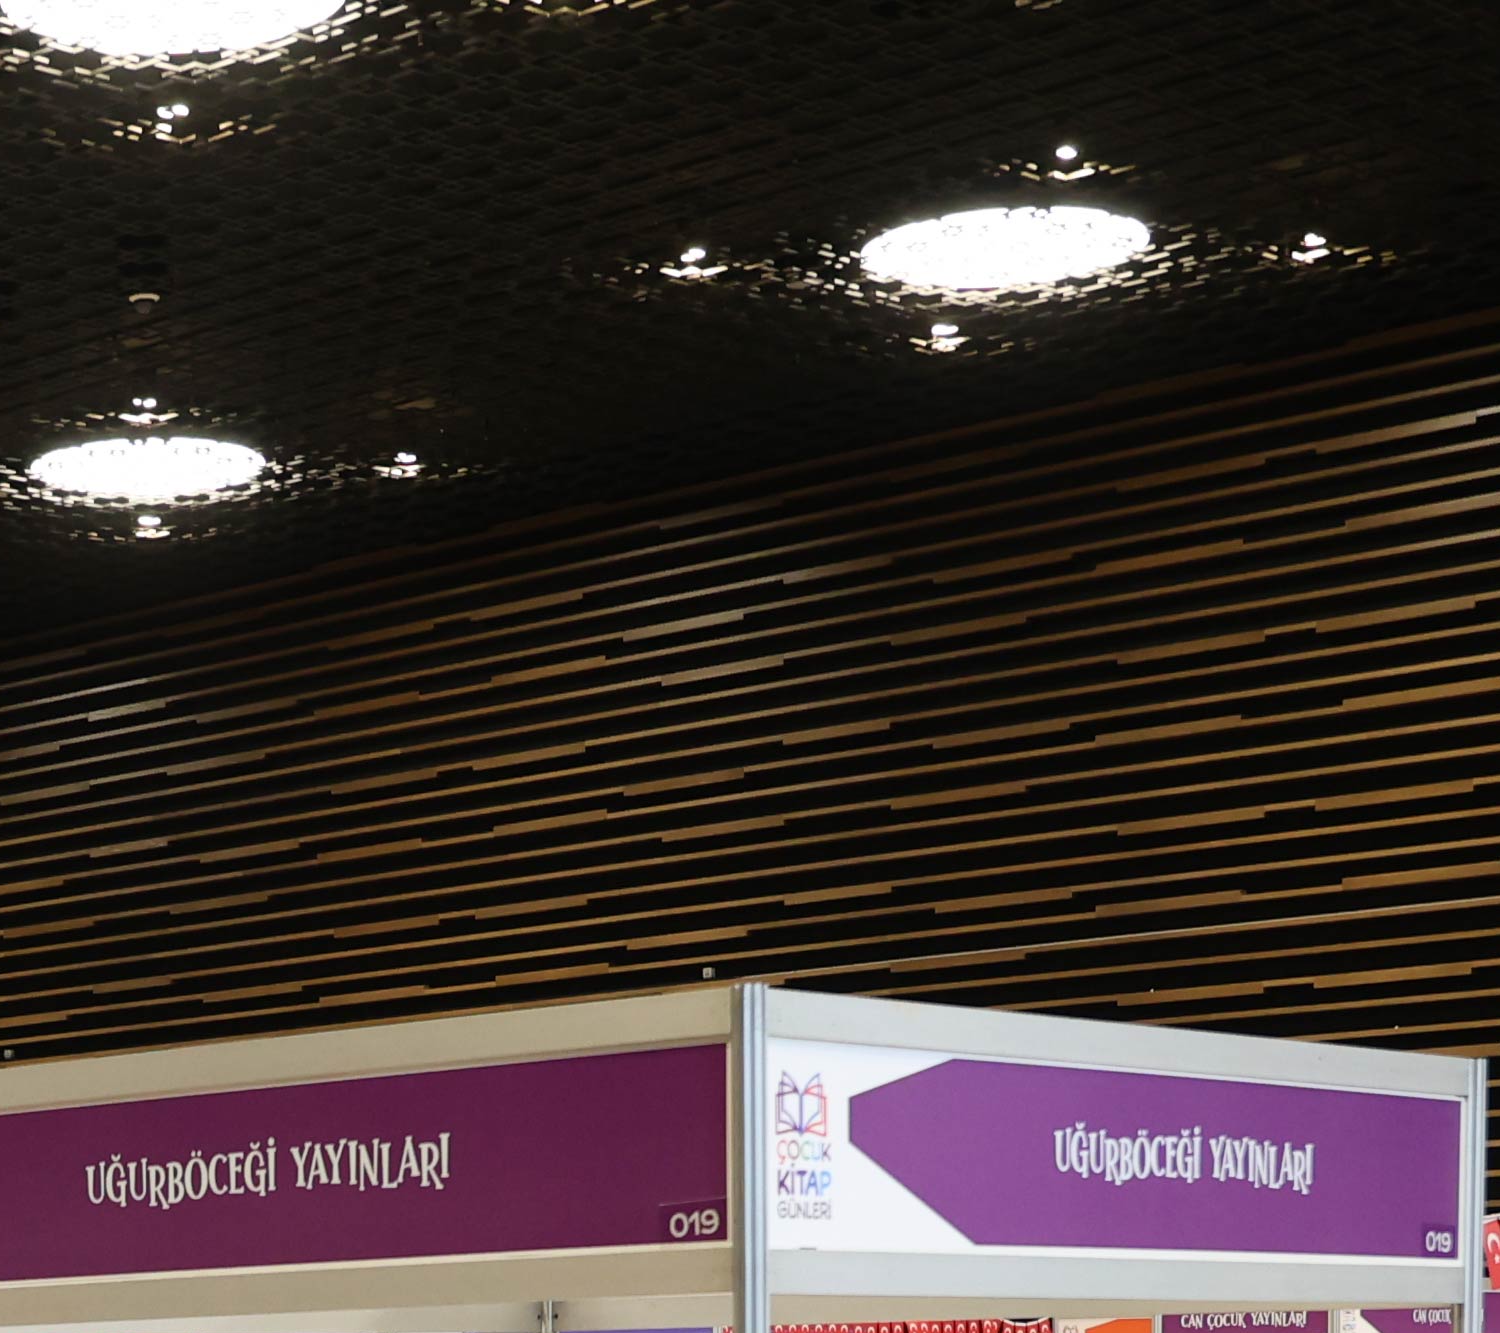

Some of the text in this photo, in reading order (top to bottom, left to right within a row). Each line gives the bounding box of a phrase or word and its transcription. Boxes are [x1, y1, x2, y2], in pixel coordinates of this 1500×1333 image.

[776, 1140, 831, 1164] ÇOCUK
[1053, 1121, 1315, 1195] UĞURBÖCEĞİ YAYINLARI
[85, 1132, 451, 1210] UĞURBÖCEĞİ YAYINLARI
[777, 1162, 832, 1196] KİTAP
[776, 1198, 832, 1220] GÜNLERİ
[669, 1208, 720, 1239] 019
[1425, 1229, 1453, 1254] 019
[1181, 1310, 1307, 1329] CAN ÇOCUK YAYINLARI
